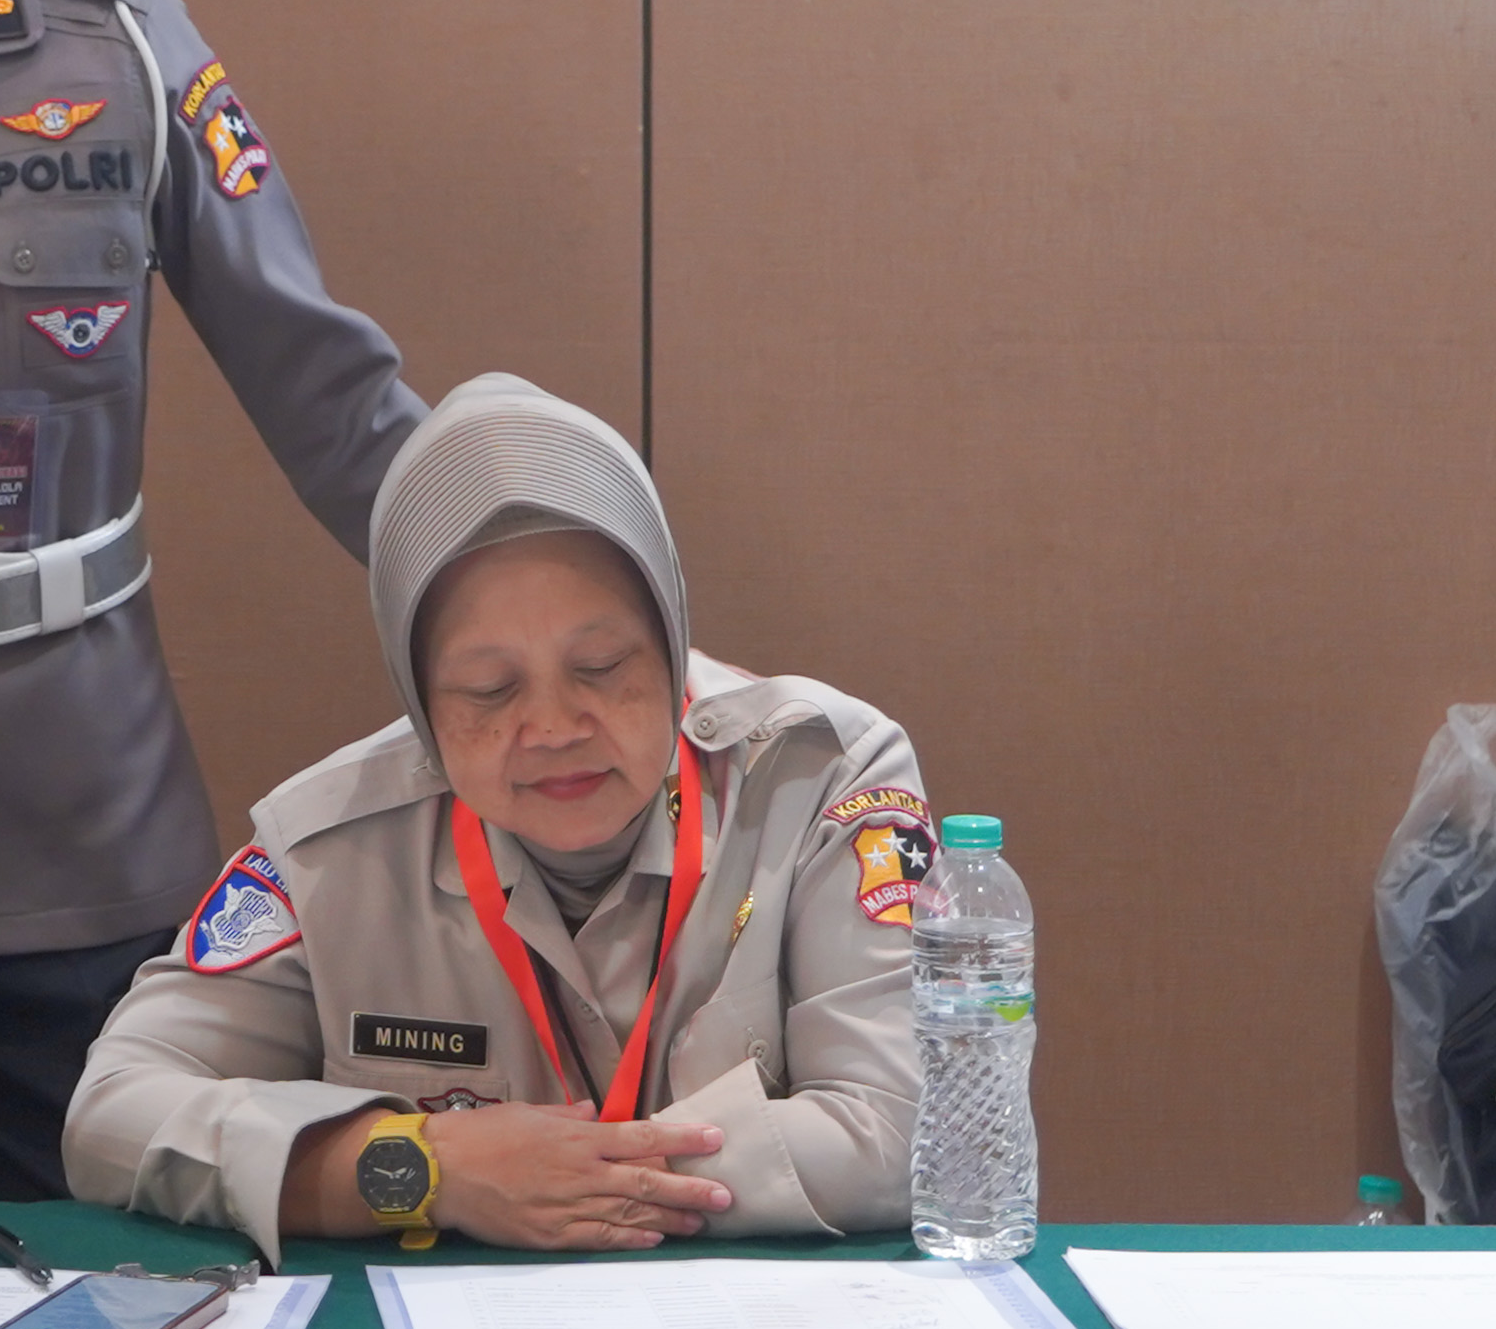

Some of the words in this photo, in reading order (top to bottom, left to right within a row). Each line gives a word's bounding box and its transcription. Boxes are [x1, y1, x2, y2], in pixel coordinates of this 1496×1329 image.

[833, 789, 925, 818] KORLANTAS
[243, 854, 276, 878] LALU
[862, 884, 908, 913] MABES
[376, 1027, 464, 1053] MINING
